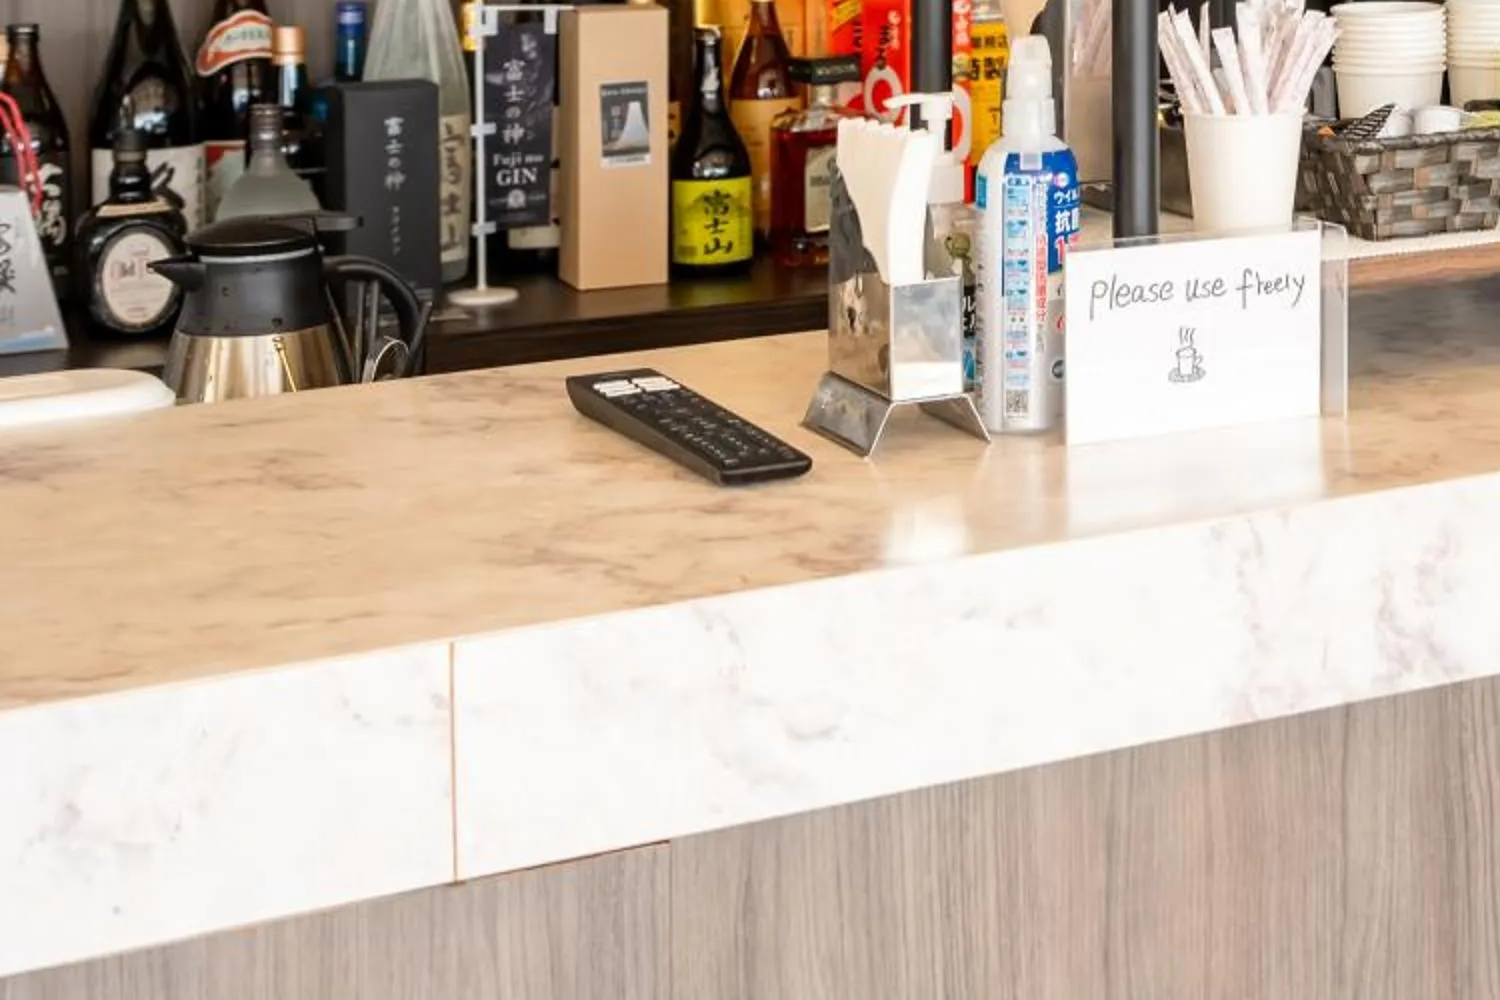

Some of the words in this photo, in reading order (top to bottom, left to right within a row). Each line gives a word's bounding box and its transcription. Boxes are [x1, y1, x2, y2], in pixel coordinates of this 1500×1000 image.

[503, 58, 526, 144] 富士の神
[493, 152, 522, 168] Fuji
[496, 167, 538, 187] GIN
[703, 189, 734, 255] 富士山
[1185, 276, 1227, 302] use
[1235, 267, 1305, 309] freely
